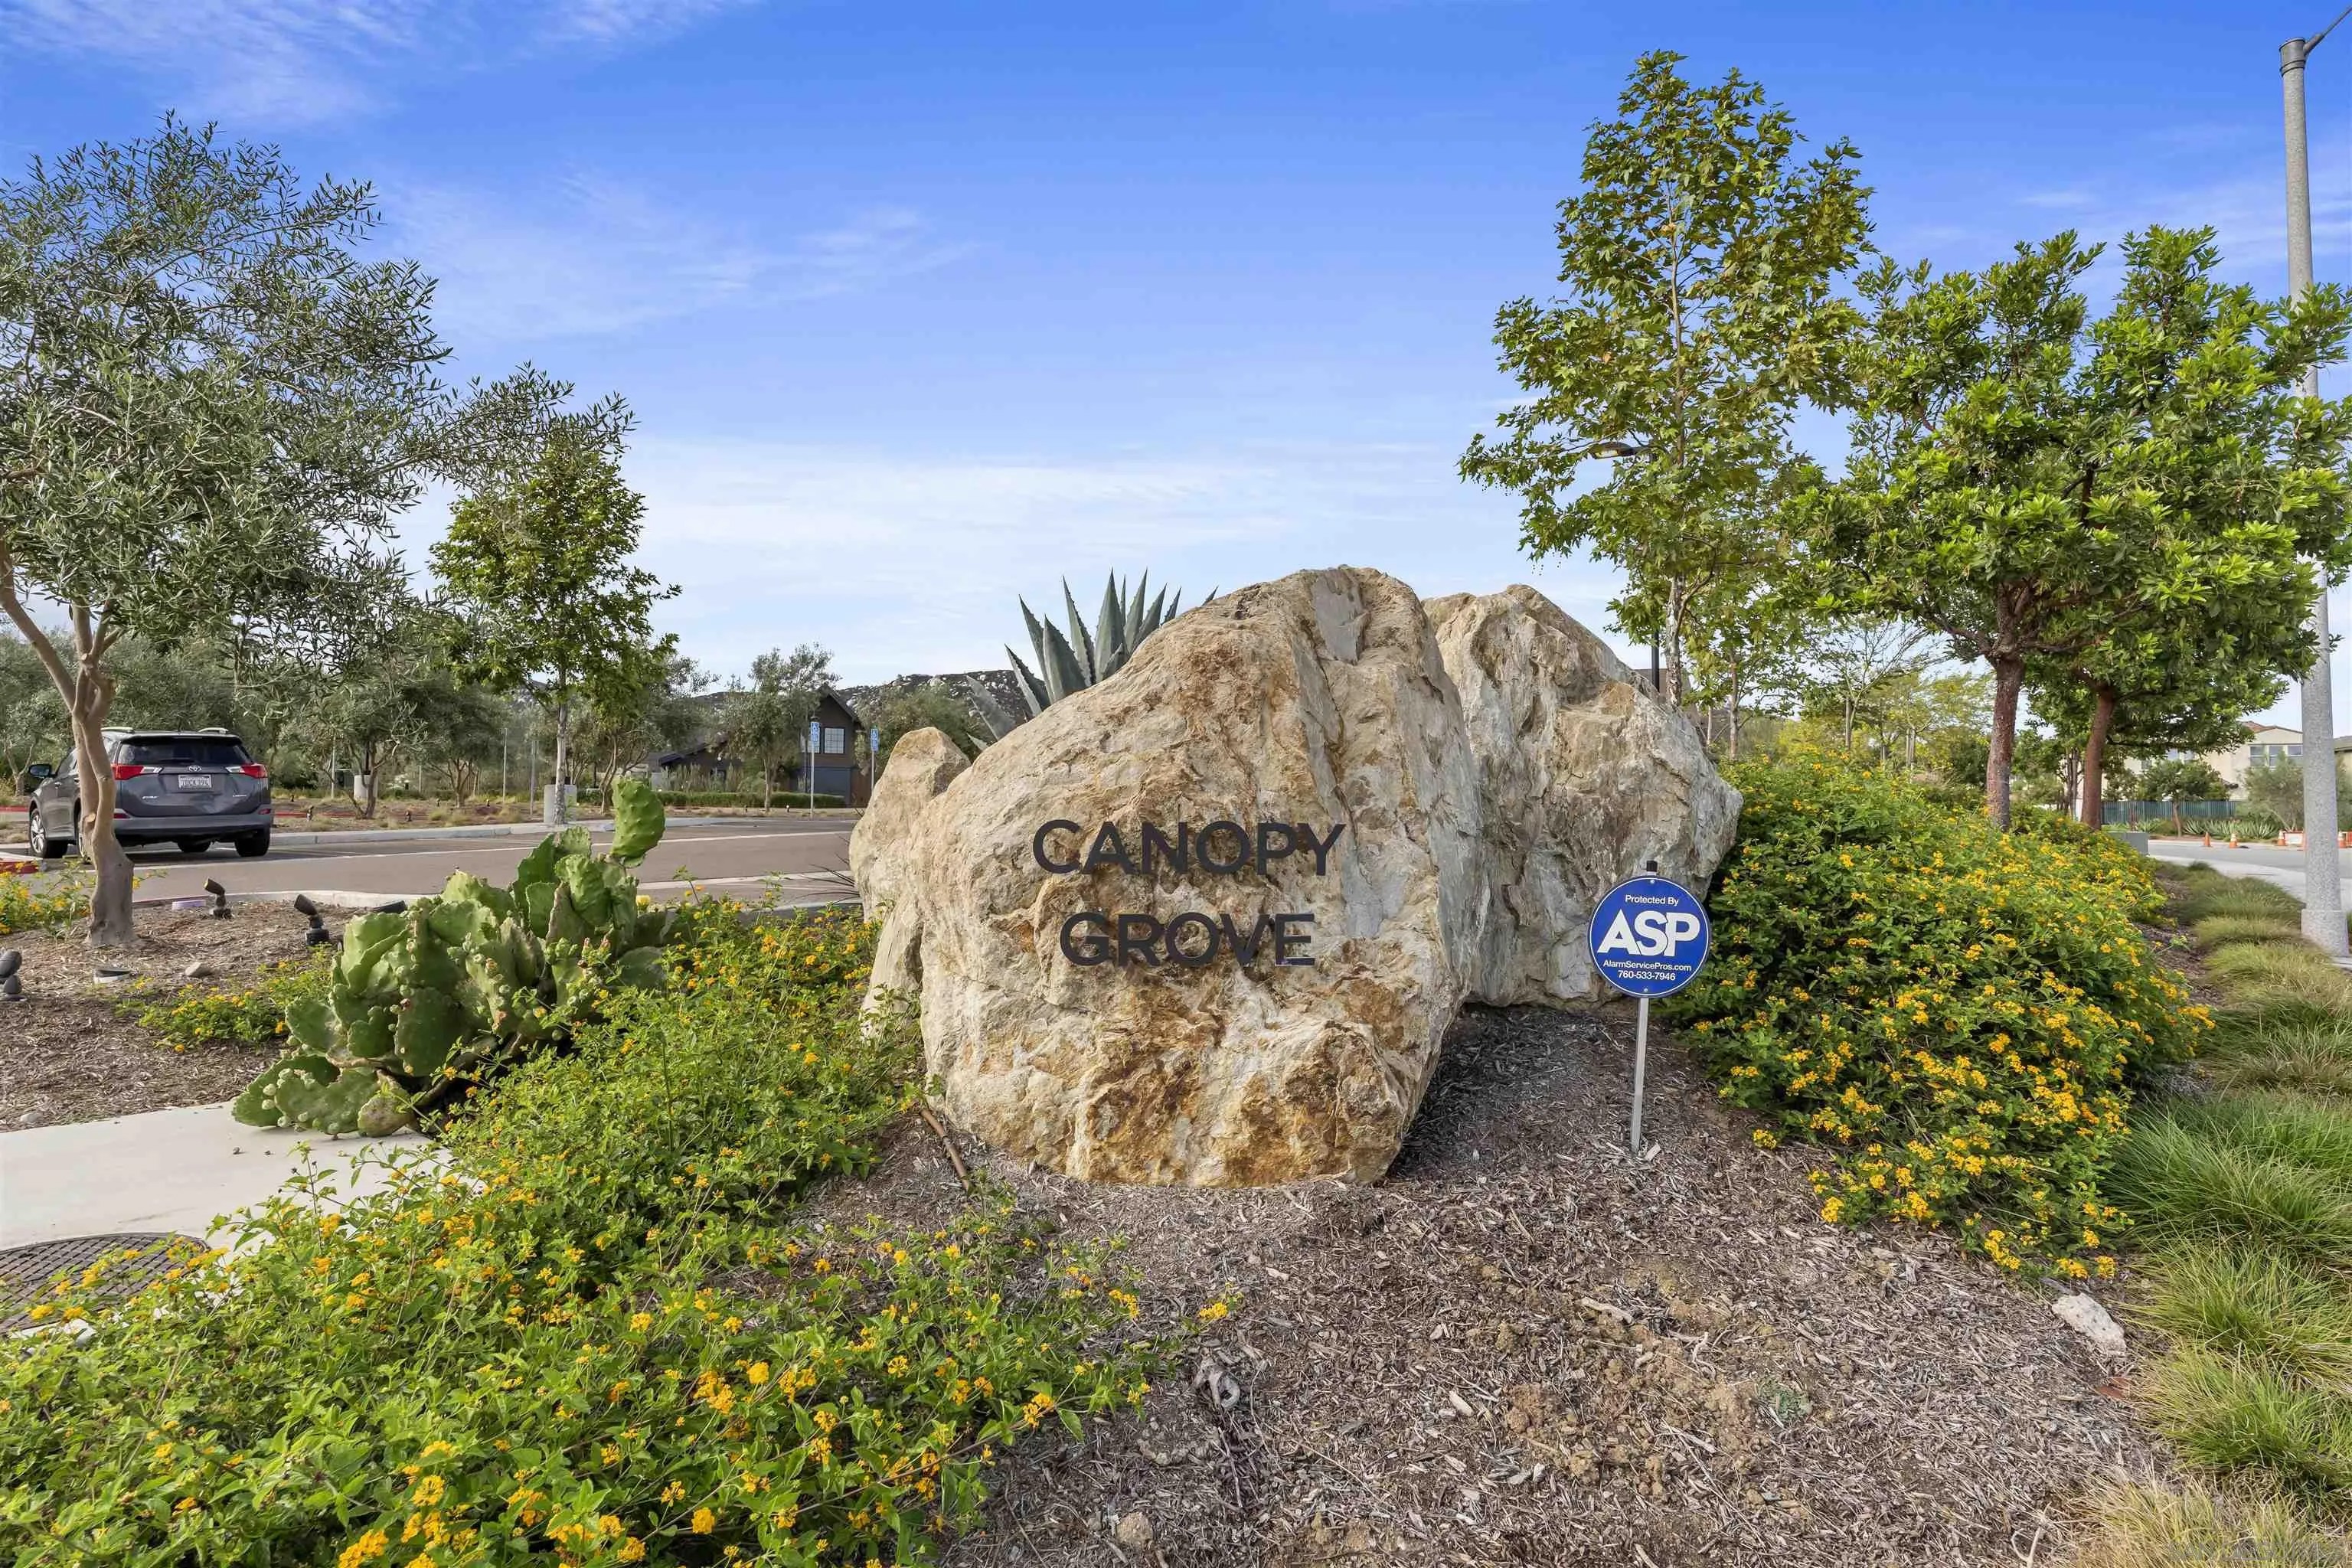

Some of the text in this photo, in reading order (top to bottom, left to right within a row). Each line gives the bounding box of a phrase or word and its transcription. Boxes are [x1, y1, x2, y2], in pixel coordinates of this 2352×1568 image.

[1033, 819, 1346, 876] CANOPY
[1625, 894, 1679, 906] Protected By
[1060, 911, 1316, 967] GROVE
[1597, 909, 1700, 957] ASP
[1603, 960, 1691, 971] AlarmServicePros.com
[1618, 970, 1676, 980] 760-533-7946
